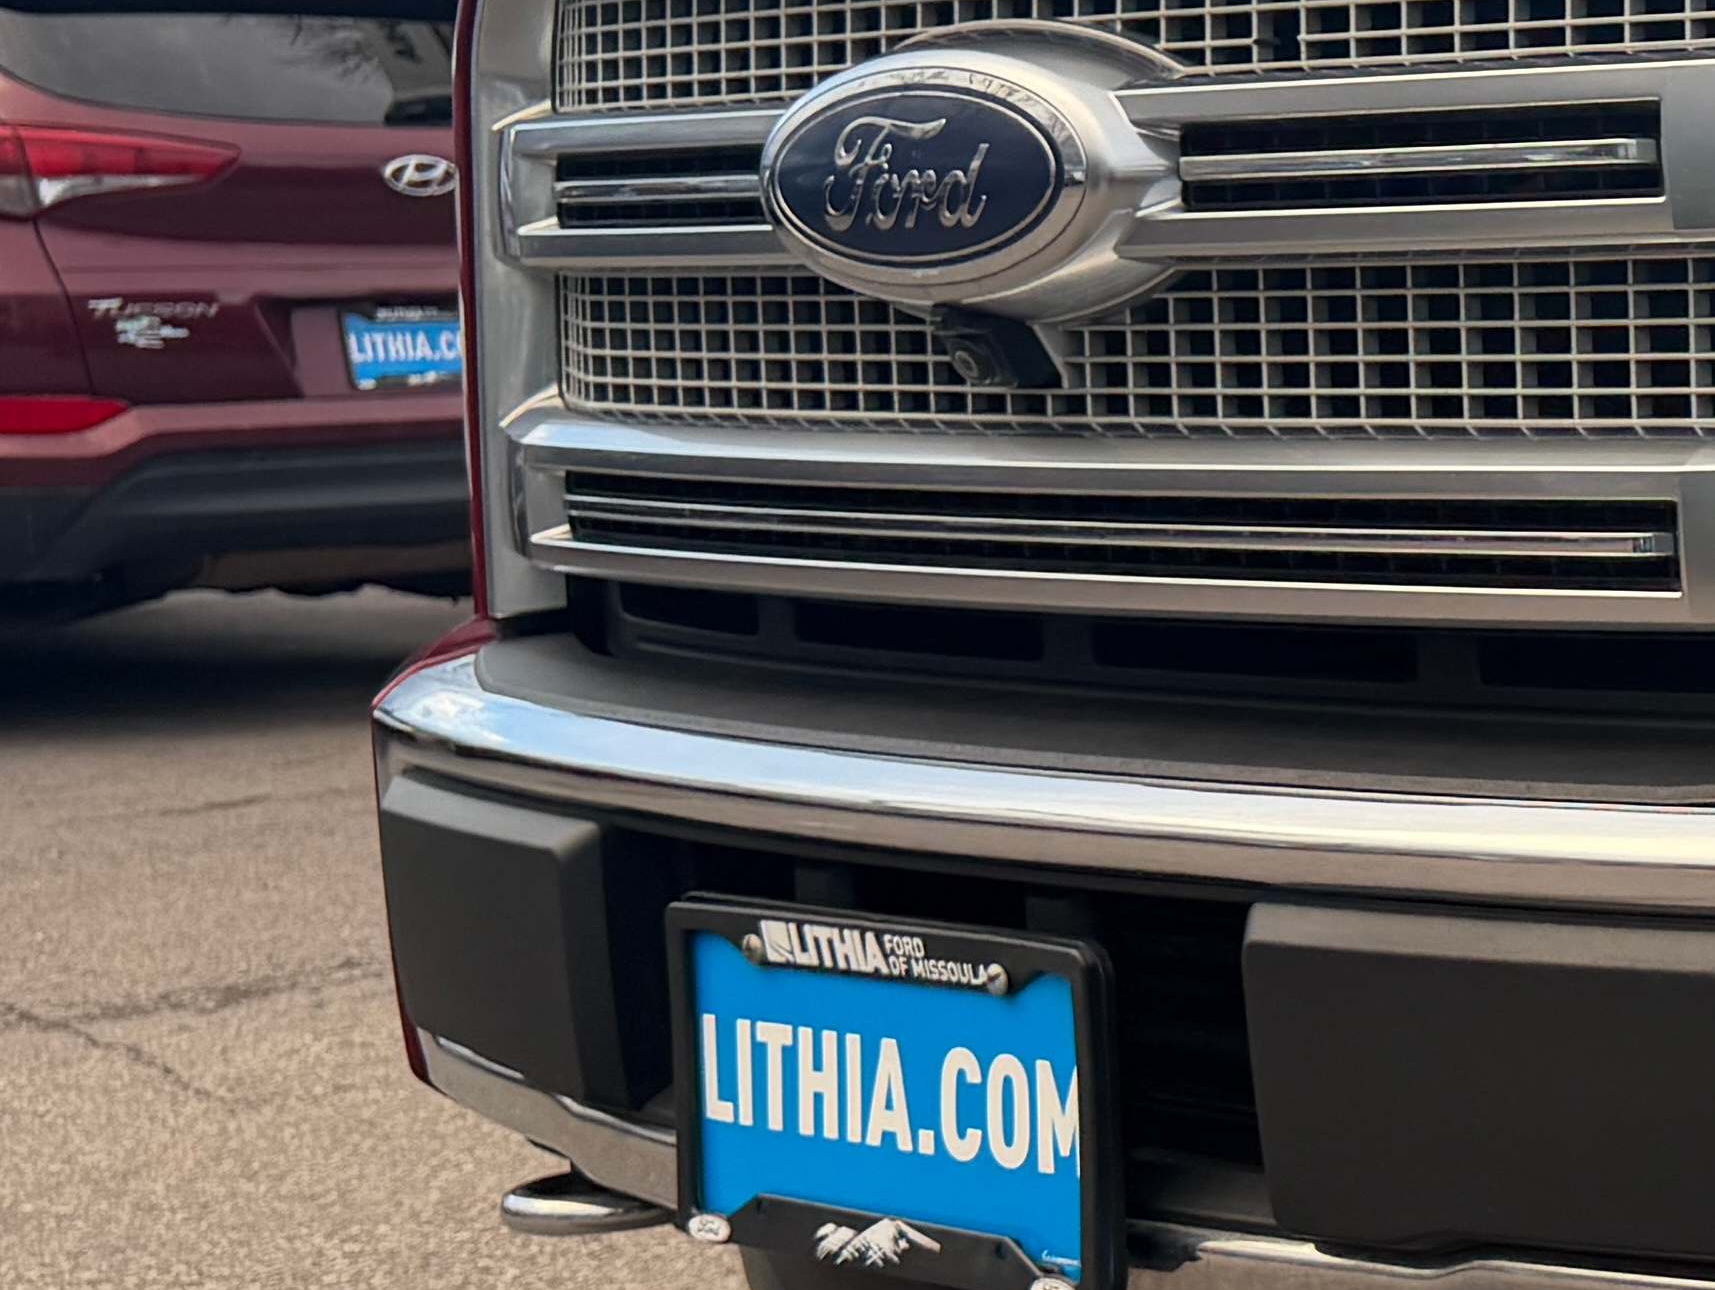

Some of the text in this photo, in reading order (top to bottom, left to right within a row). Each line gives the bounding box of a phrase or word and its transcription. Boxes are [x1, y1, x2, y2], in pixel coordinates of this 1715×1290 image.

[823, 115, 989, 232] Ford
[788, 922, 890, 977] LITHIA
[884, 934, 926, 959] FORD
[890, 957, 989, 986] OF MISSOULA
[702, 1013, 1081, 1178] LITHIA.COM
